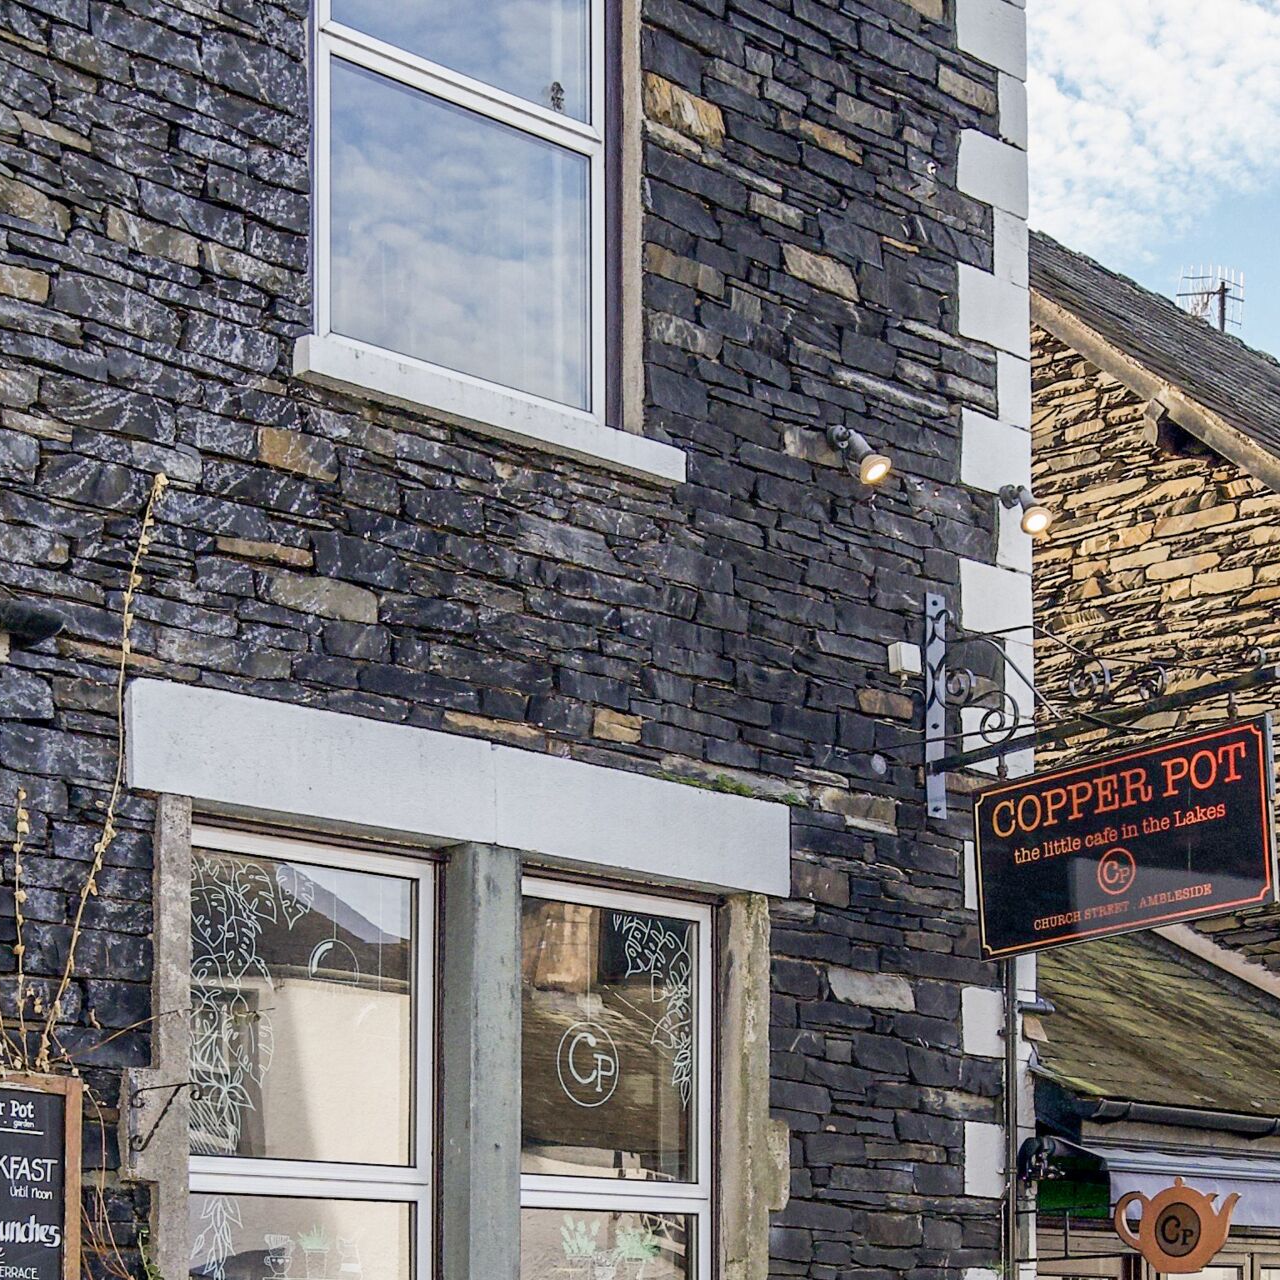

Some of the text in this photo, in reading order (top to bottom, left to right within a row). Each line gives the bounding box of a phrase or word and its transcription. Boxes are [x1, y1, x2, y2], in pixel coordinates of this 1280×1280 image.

[992, 741, 1246, 838] COPPER POT
[1014, 847, 1040, 864] the
[1043, 836, 1081, 858] little
[1121, 823, 1138, 839] in
[1142, 816, 1170, 834] the
[1173, 803, 1226, 827] Lakes
[1034, 883, 1212, 931] CHURCH STREET AMBLESIDE
[10, 1100, 35, 1118] Pot
[10, 1185, 29, 1198] Until
